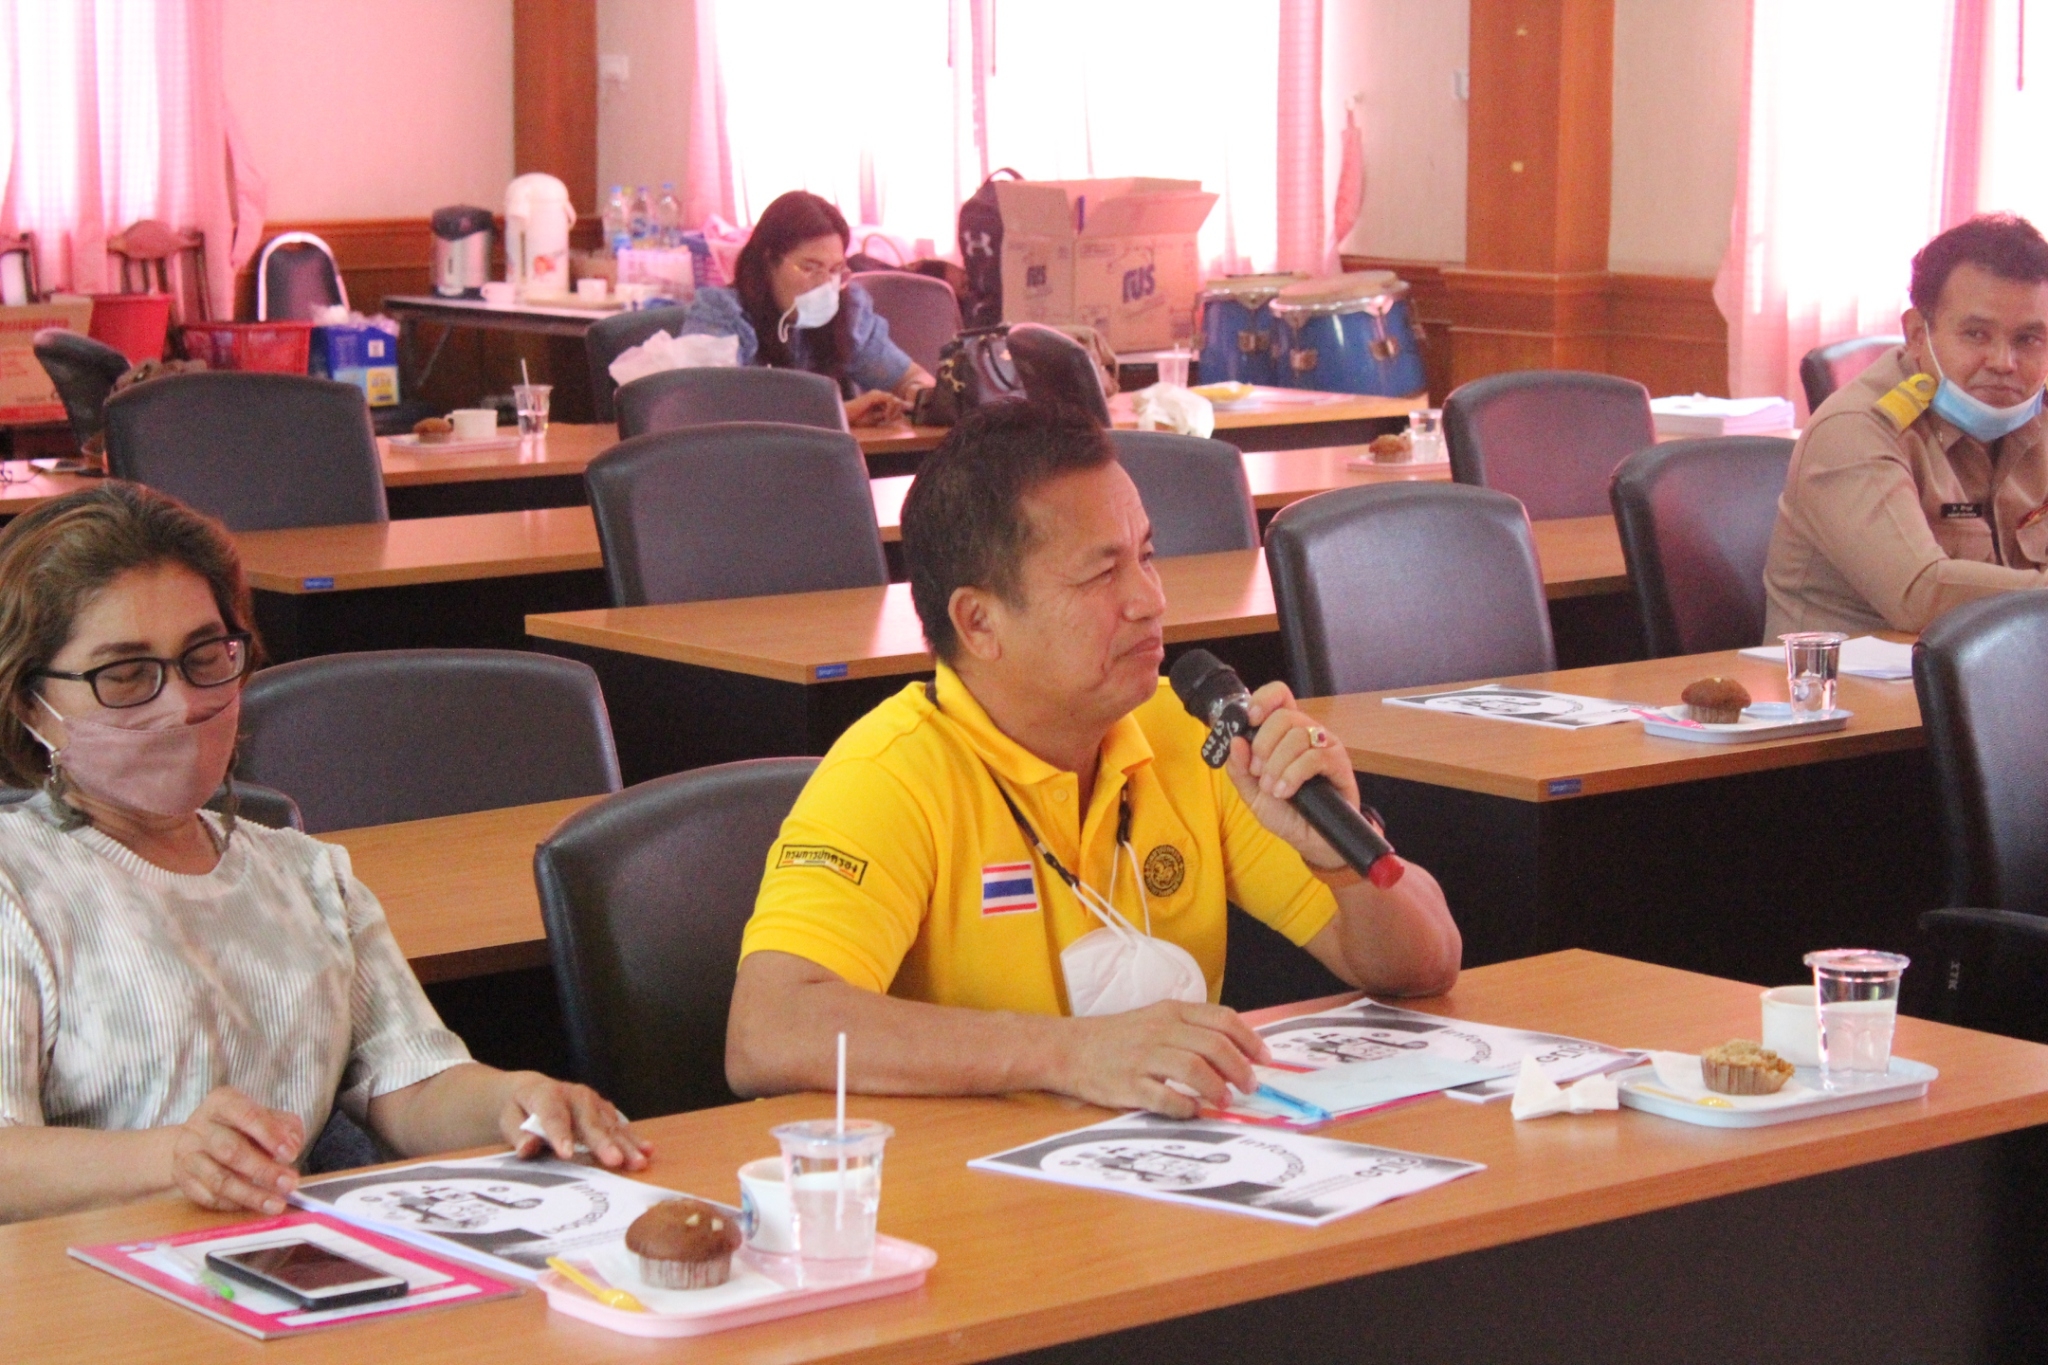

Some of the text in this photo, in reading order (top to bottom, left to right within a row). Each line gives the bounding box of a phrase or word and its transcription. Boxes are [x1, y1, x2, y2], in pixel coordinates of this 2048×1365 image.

[784, 849, 858, 873] กรมการปกครอง
